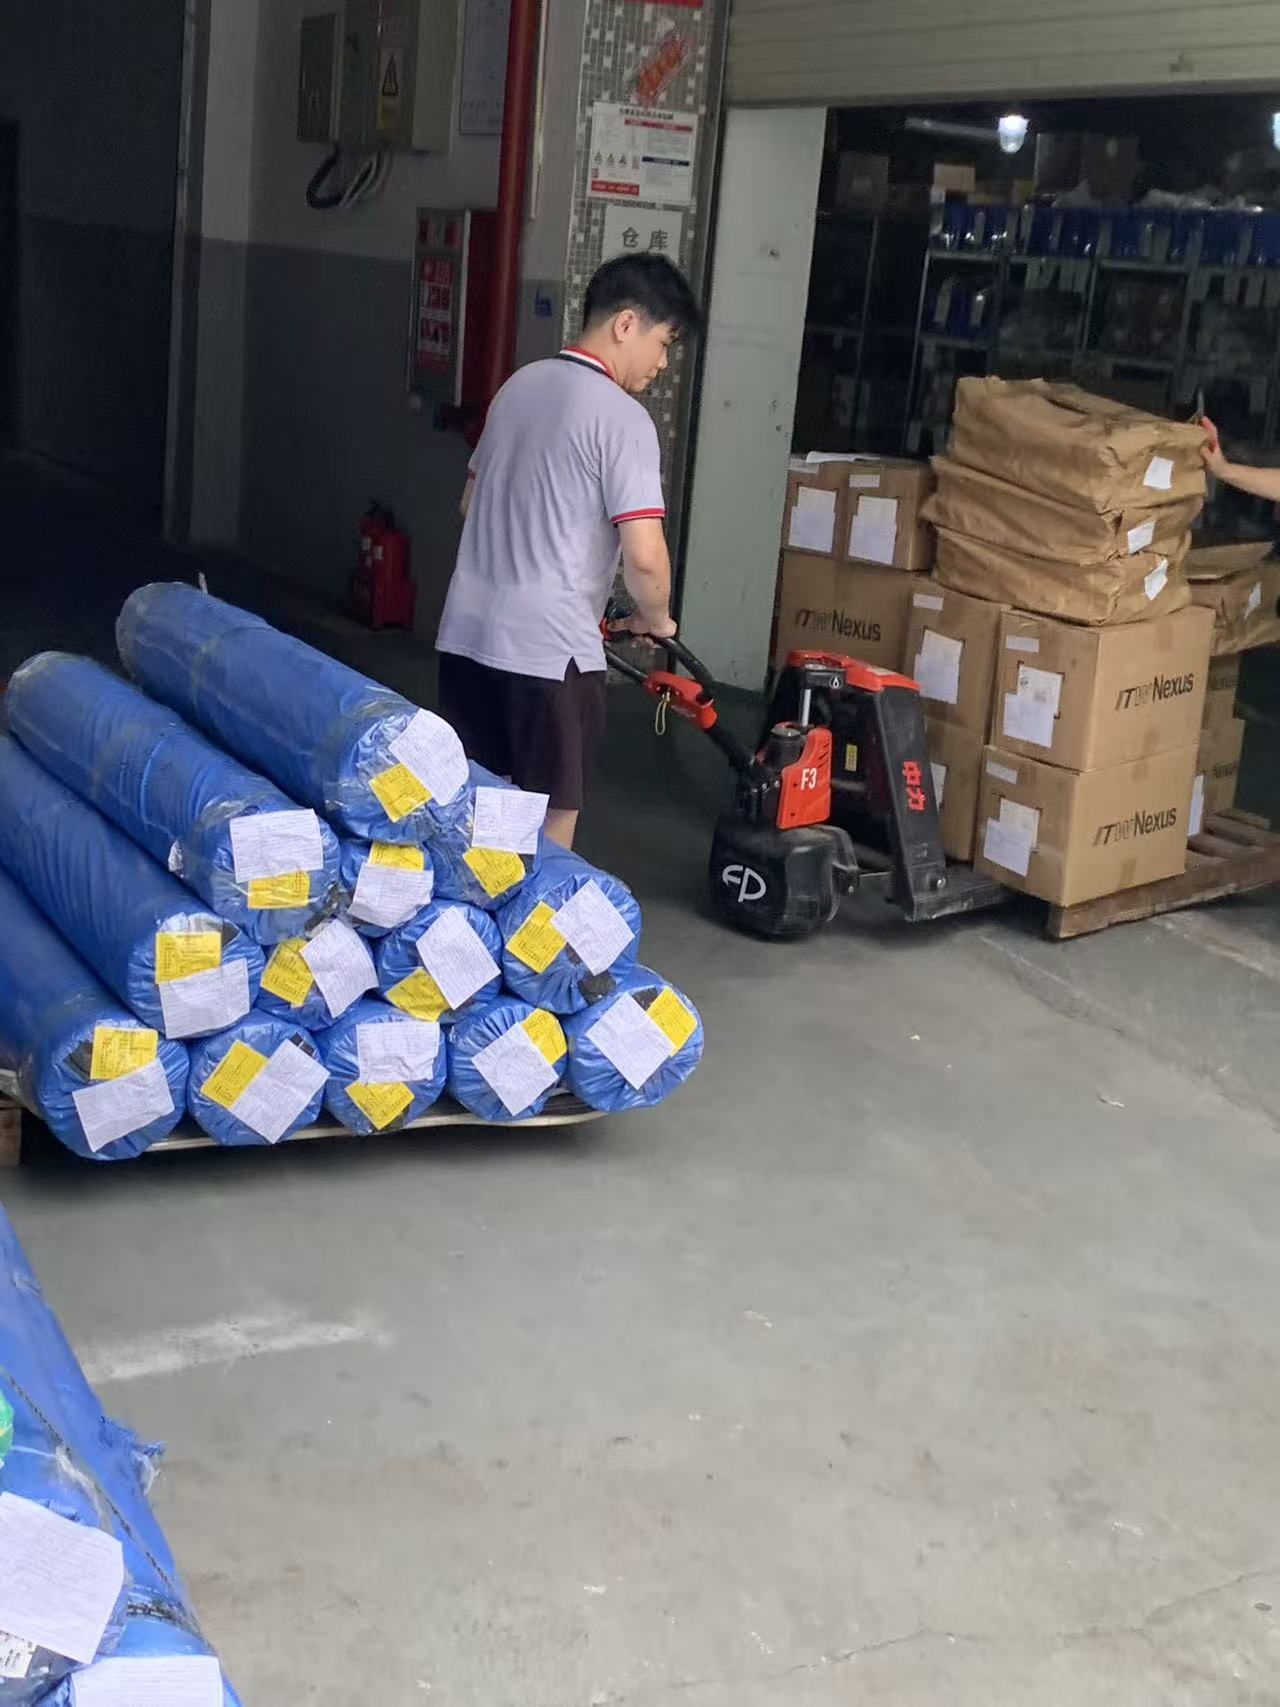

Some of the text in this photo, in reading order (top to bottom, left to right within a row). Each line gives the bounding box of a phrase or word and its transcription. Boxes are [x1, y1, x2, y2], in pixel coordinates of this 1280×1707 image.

[621, 226, 669, 250] 仓库
[832, 609, 881, 642] Nexus
[1152, 673, 1194, 702] Nexus
[800, 767, 817, 791] F3
[1133, 807, 1177, 837] Nexus
